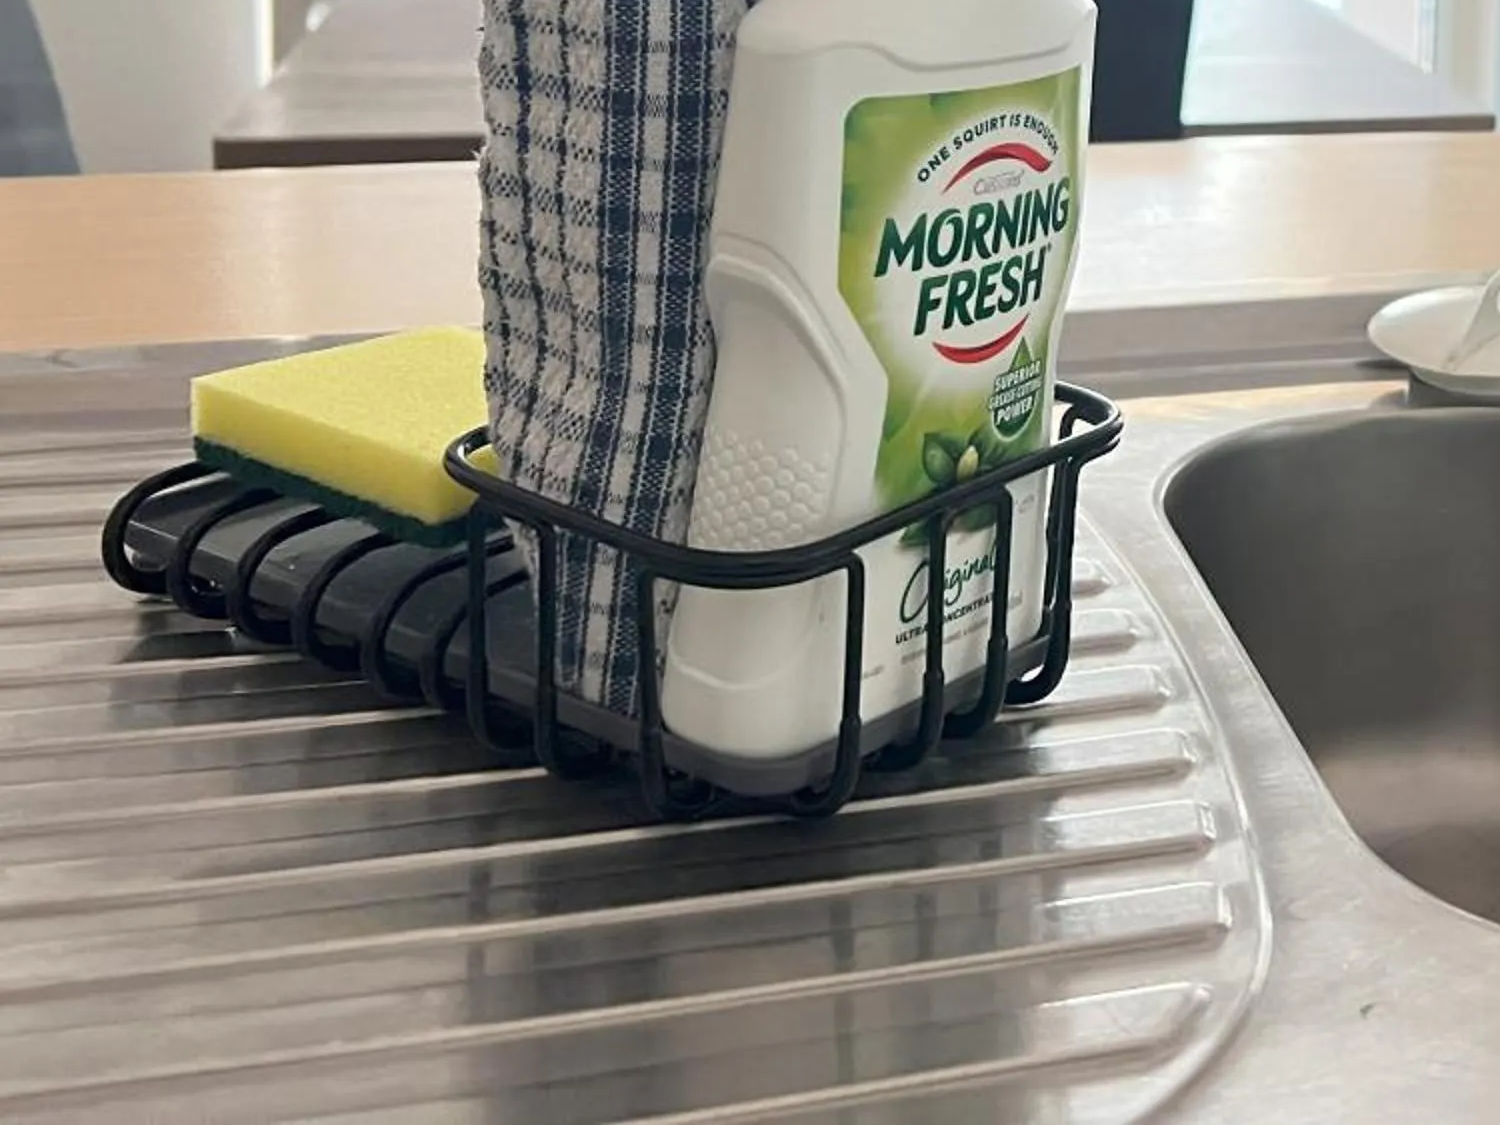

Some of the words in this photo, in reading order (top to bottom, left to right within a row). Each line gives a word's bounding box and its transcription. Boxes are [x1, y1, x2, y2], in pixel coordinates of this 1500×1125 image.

[917, 146, 951, 182] ONE
[953, 114, 1008, 150] SQUIRT
[1009, 114, 1022, 128] IS
[1023, 114, 1059, 156] ENOUGH
[873, 177, 1070, 277] MORNING
[913, 247, 1046, 336] FRESH
[900, 539, 998, 623] Oiginal
